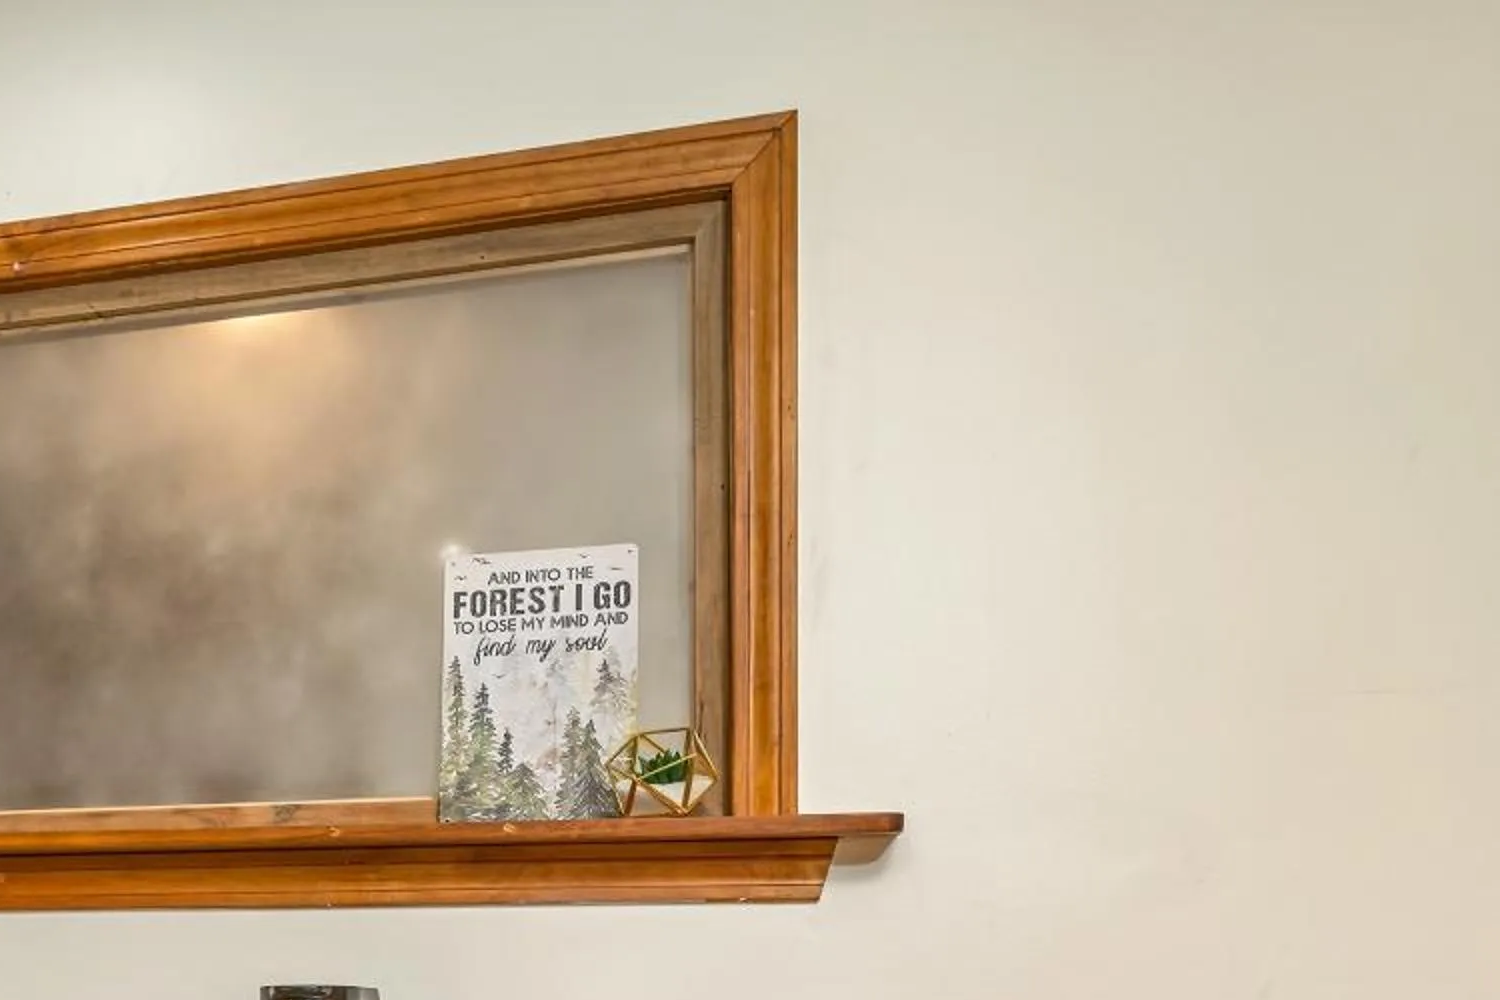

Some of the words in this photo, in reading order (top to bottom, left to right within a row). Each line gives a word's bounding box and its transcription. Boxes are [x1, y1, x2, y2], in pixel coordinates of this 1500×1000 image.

[487, 571, 521, 585] AND
[525, 568, 561, 583] INTO
[566, 565, 594, 581] THE
[453, 584, 565, 619] FOREST
[575, 583, 583, 611] I
[593, 580, 631, 610] GO
[453, 620, 475, 635] TO
[479, 617, 517, 634] LOSE
[521, 616, 545, 632] MY
[550, 613, 589, 630] MIND
[594, 611, 628, 627] AND
[473, 634, 516, 666] find
[525, 638, 556, 663] my
[565, 628, 608, 652] soul
